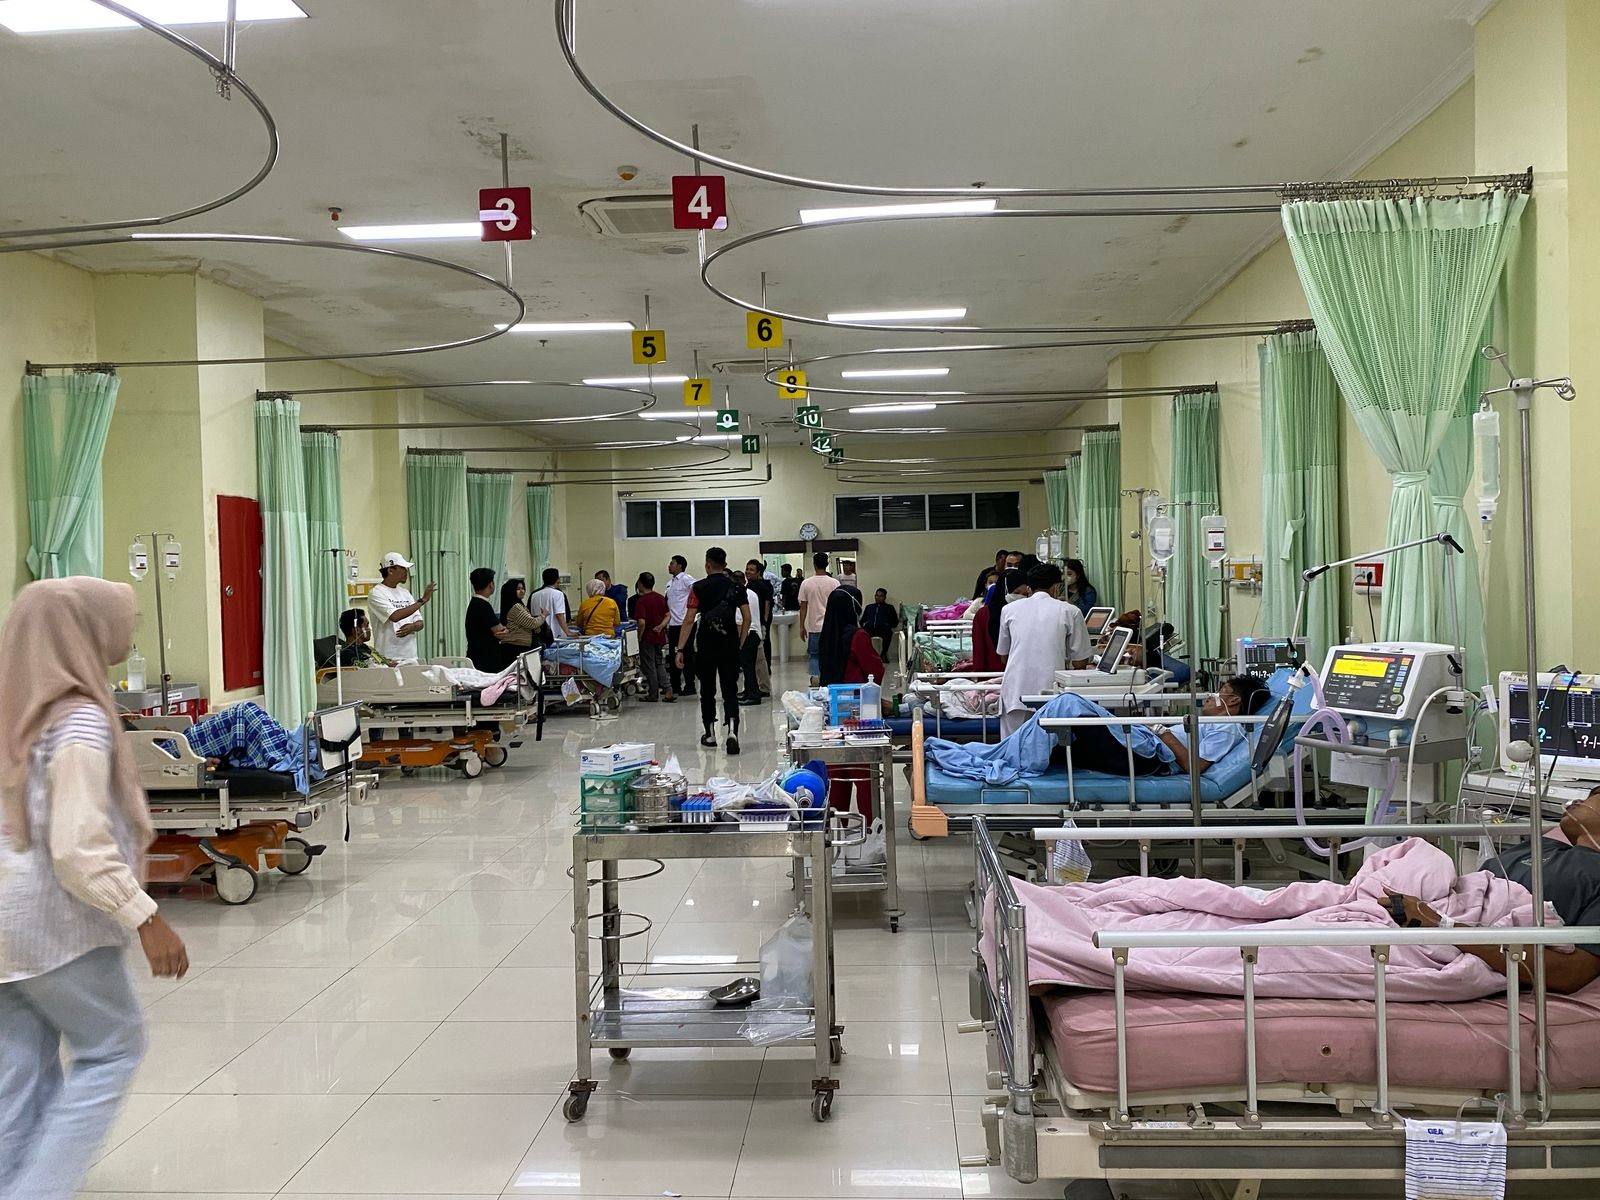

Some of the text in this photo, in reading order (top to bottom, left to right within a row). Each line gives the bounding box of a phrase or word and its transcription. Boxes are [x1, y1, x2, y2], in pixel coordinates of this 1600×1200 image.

[687, 185, 712, 220] 4
[495, 197, 517, 231] 3
[757, 318, 773, 342] 6
[642, 336, 656, 358] 5
[691, 383, 703, 401] 7
[786, 375, 798, 394] 8
[802, 409, 819, 425] 10
[744, 438, 758, 451] 11
[816, 437, 830, 449] 12
